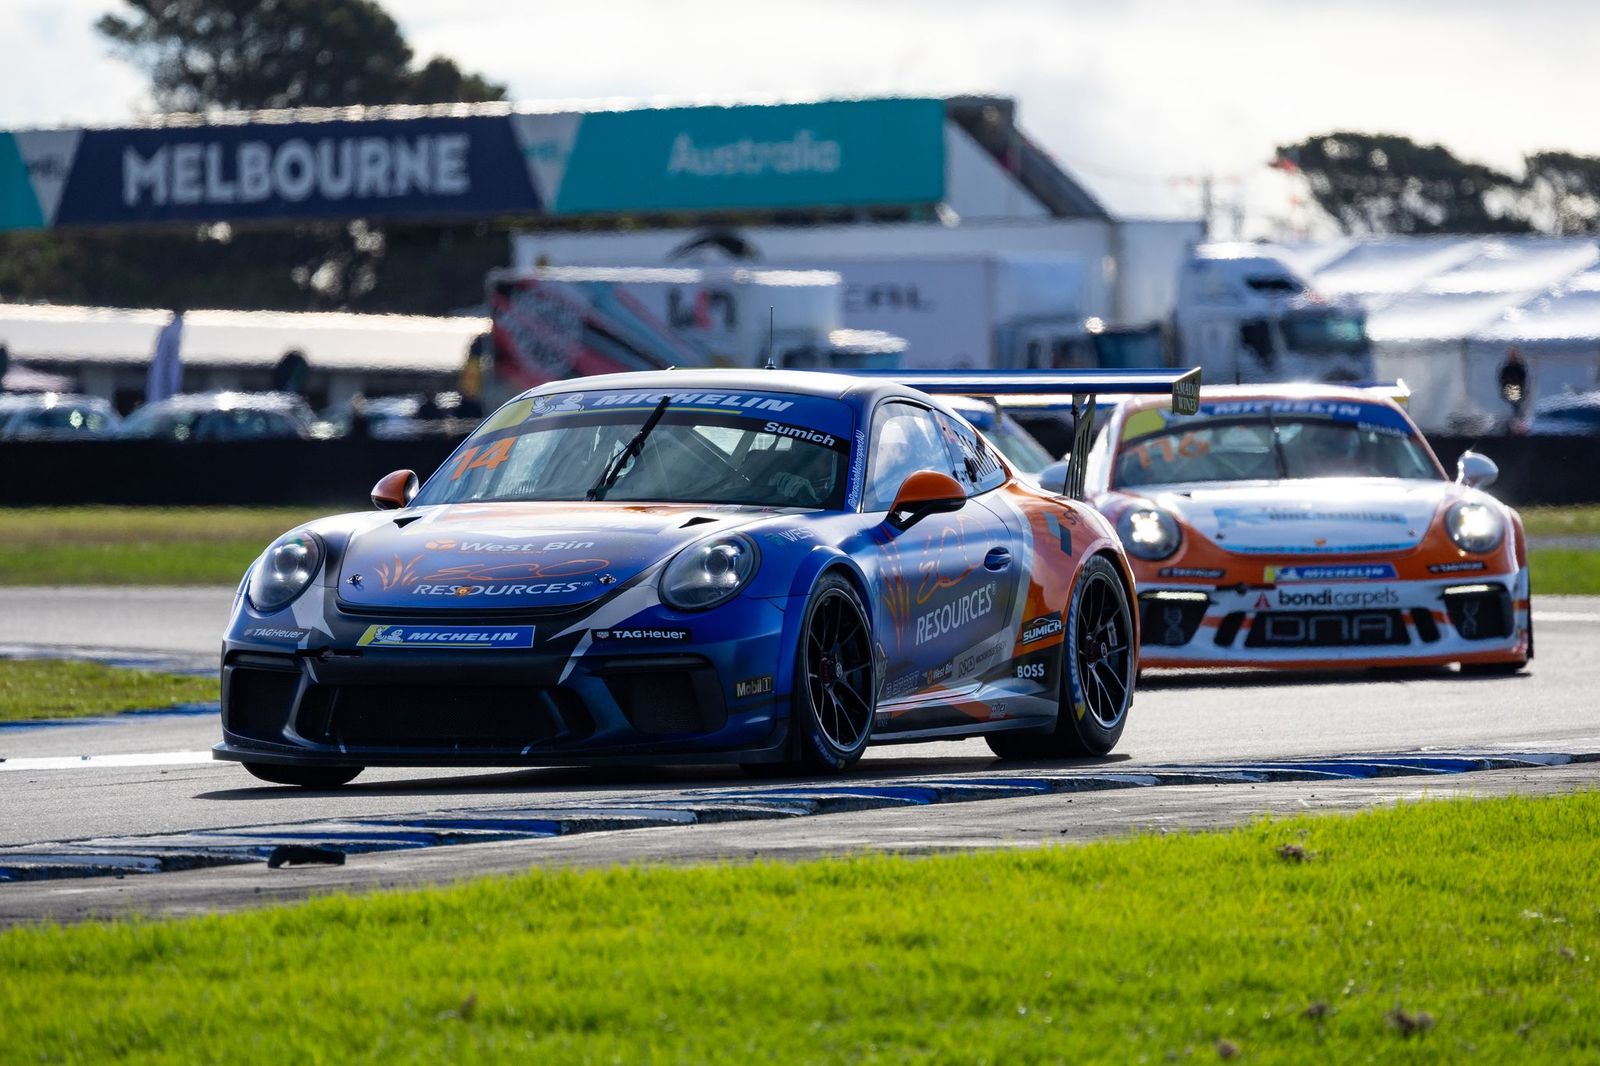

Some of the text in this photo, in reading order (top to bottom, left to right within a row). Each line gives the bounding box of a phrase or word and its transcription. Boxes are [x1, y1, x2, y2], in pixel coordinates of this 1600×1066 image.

[668, 130, 840, 176] Australia
[123, 133, 469, 206] MELBOURNE
[592, 393, 794, 413] MICHELIN
[1213, 402, 1360, 414] MICHELIN
[763, 420, 836, 447] Sumich
[450, 437, 516, 482] 14
[460, 541, 595, 551] West Bin
[1303, 568, 1385, 578] MICHELIN
[412, 582, 581, 596] RESOURCES
[915, 585, 993, 646] RESOURCES
[408, 632, 518, 642] MICHELIN
[1023, 622, 1062, 642] SUMICH
[1017, 664, 1045, 677] BOSS
[736, 682, 762, 697] Mobil
